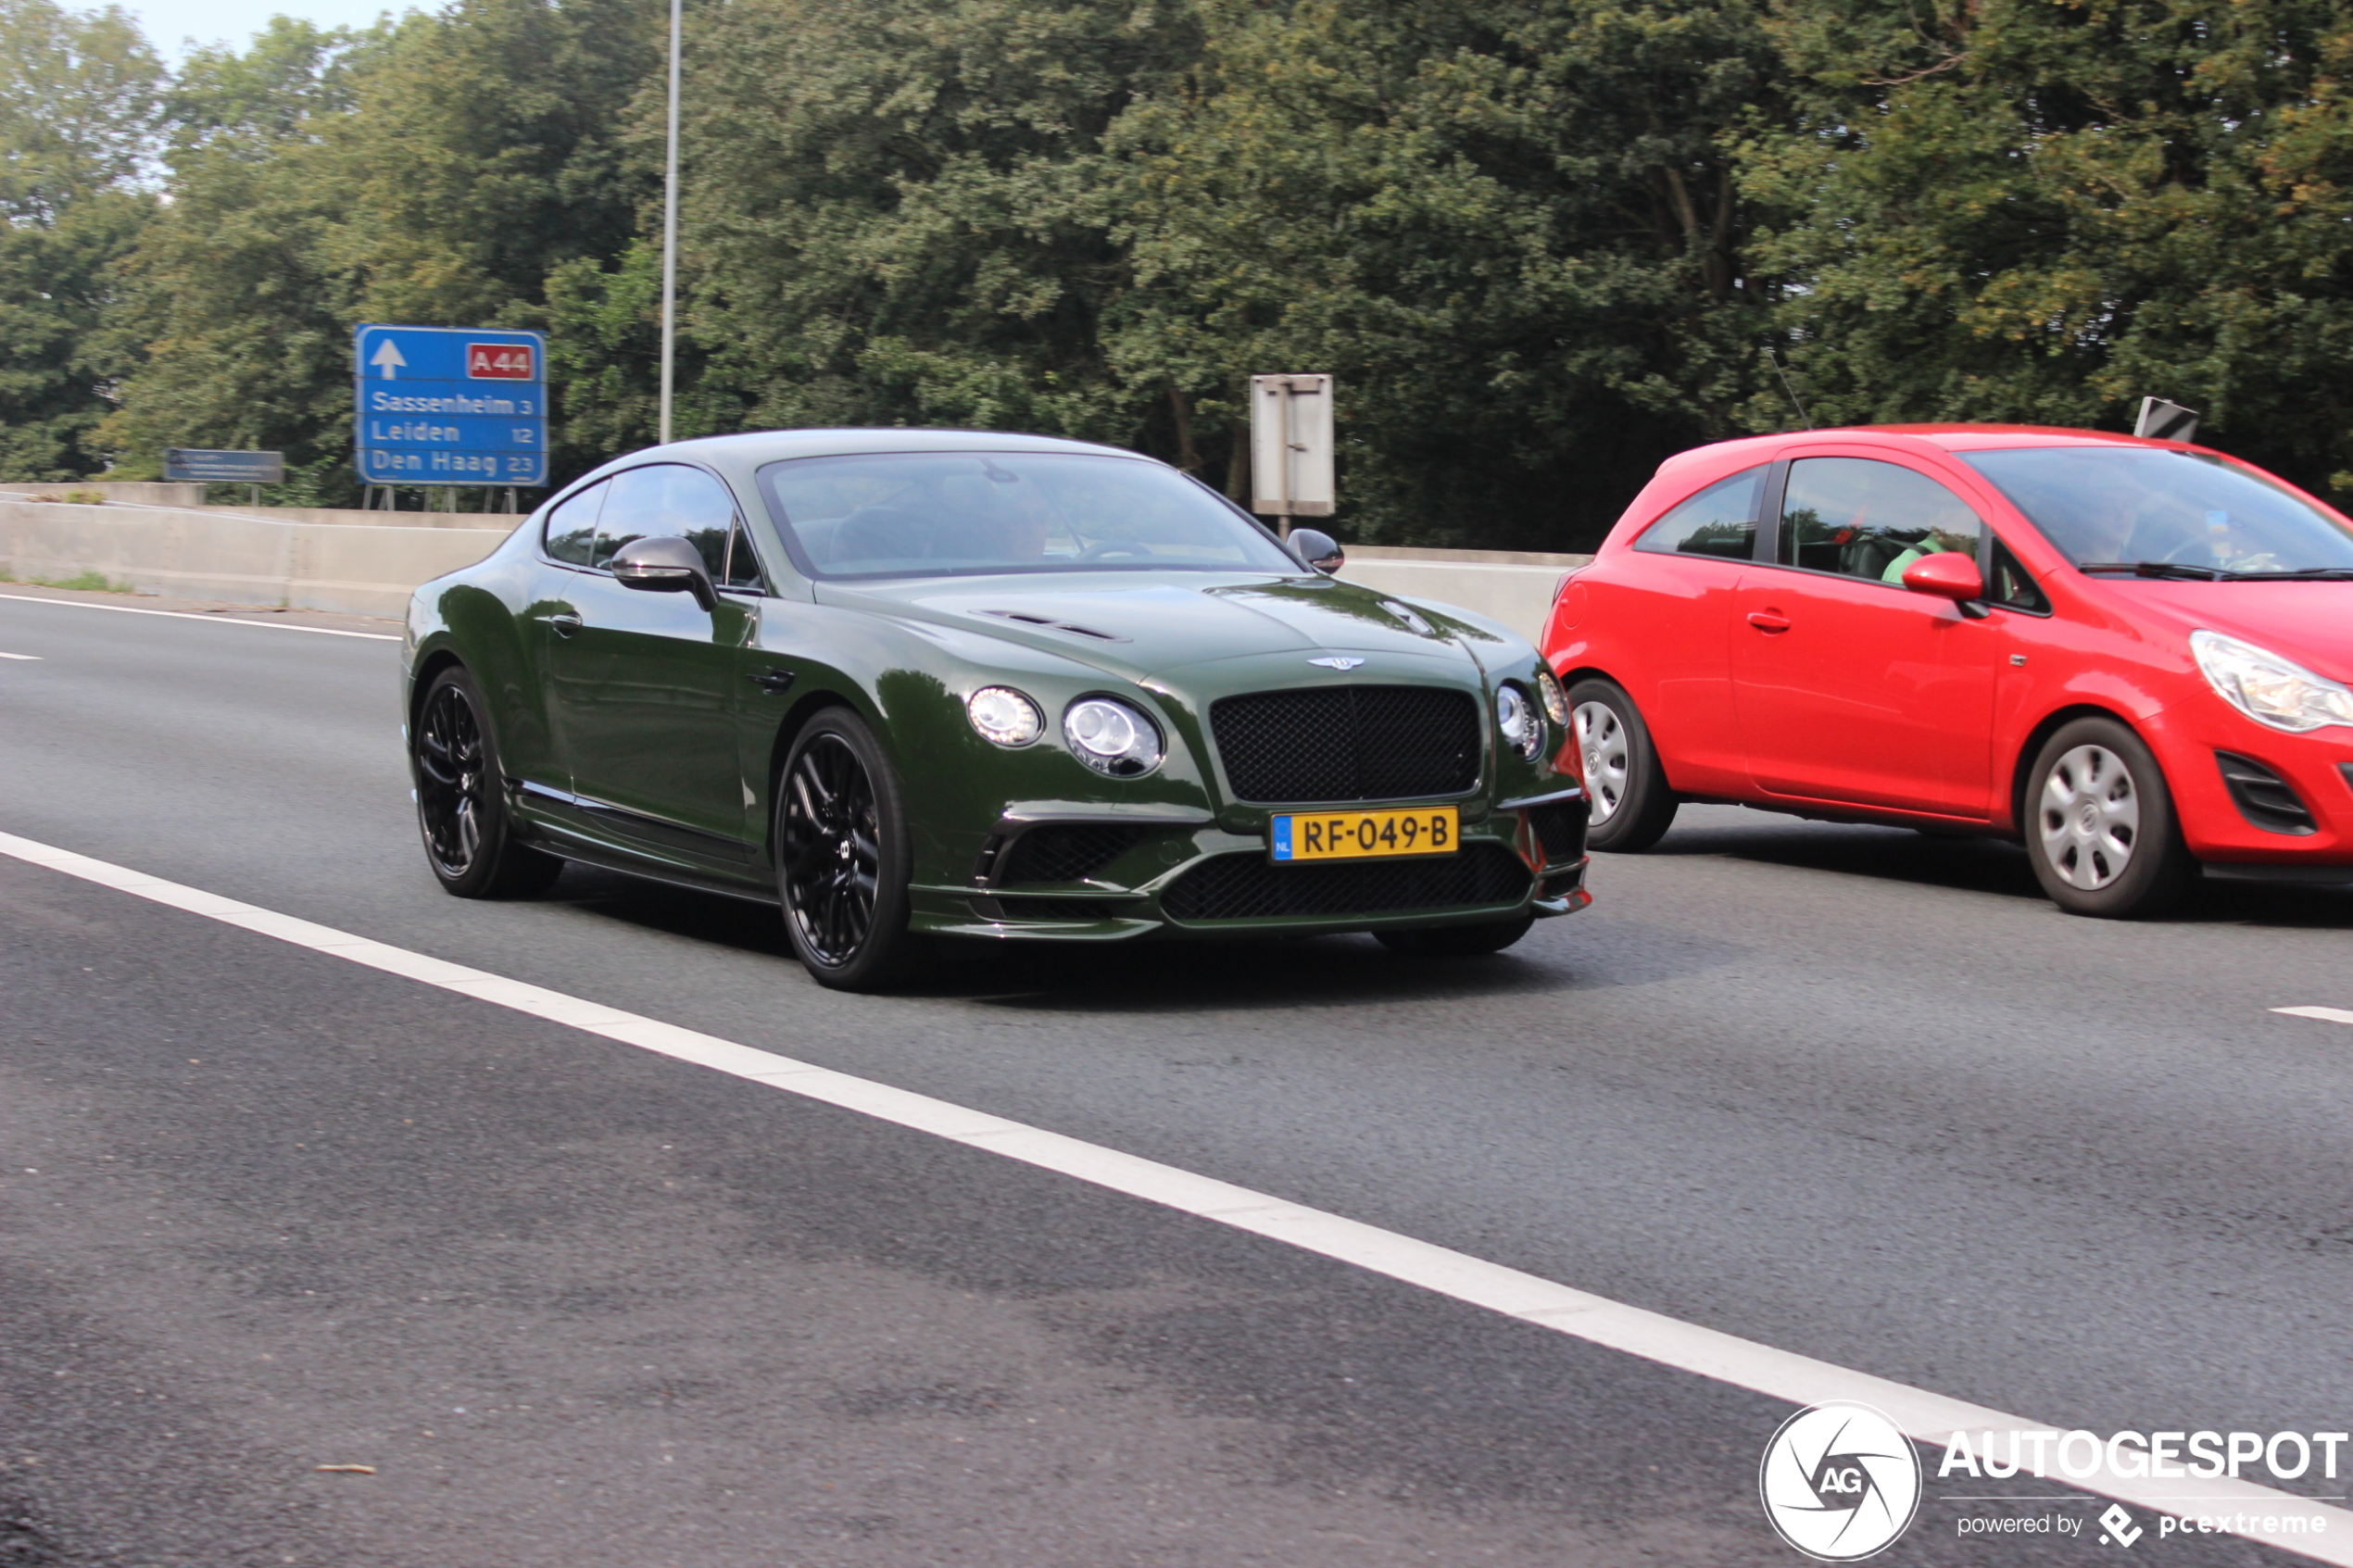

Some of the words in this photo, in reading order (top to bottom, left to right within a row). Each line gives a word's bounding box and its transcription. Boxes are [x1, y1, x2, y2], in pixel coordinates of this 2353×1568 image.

[471, 352, 529, 371] A44
[371, 392, 514, 414] Sassenheim
[519, 400, 534, 415] 3
[371, 420, 459, 442] Leiden
[511, 428, 534, 444] 12
[371, 449, 422, 470] Den
[432, 451, 497, 477] Haag
[507, 457, 534, 472] 23
[1304, 815, 1447, 852] RF-049-B
[1276, 842, 1290, 852] NL
